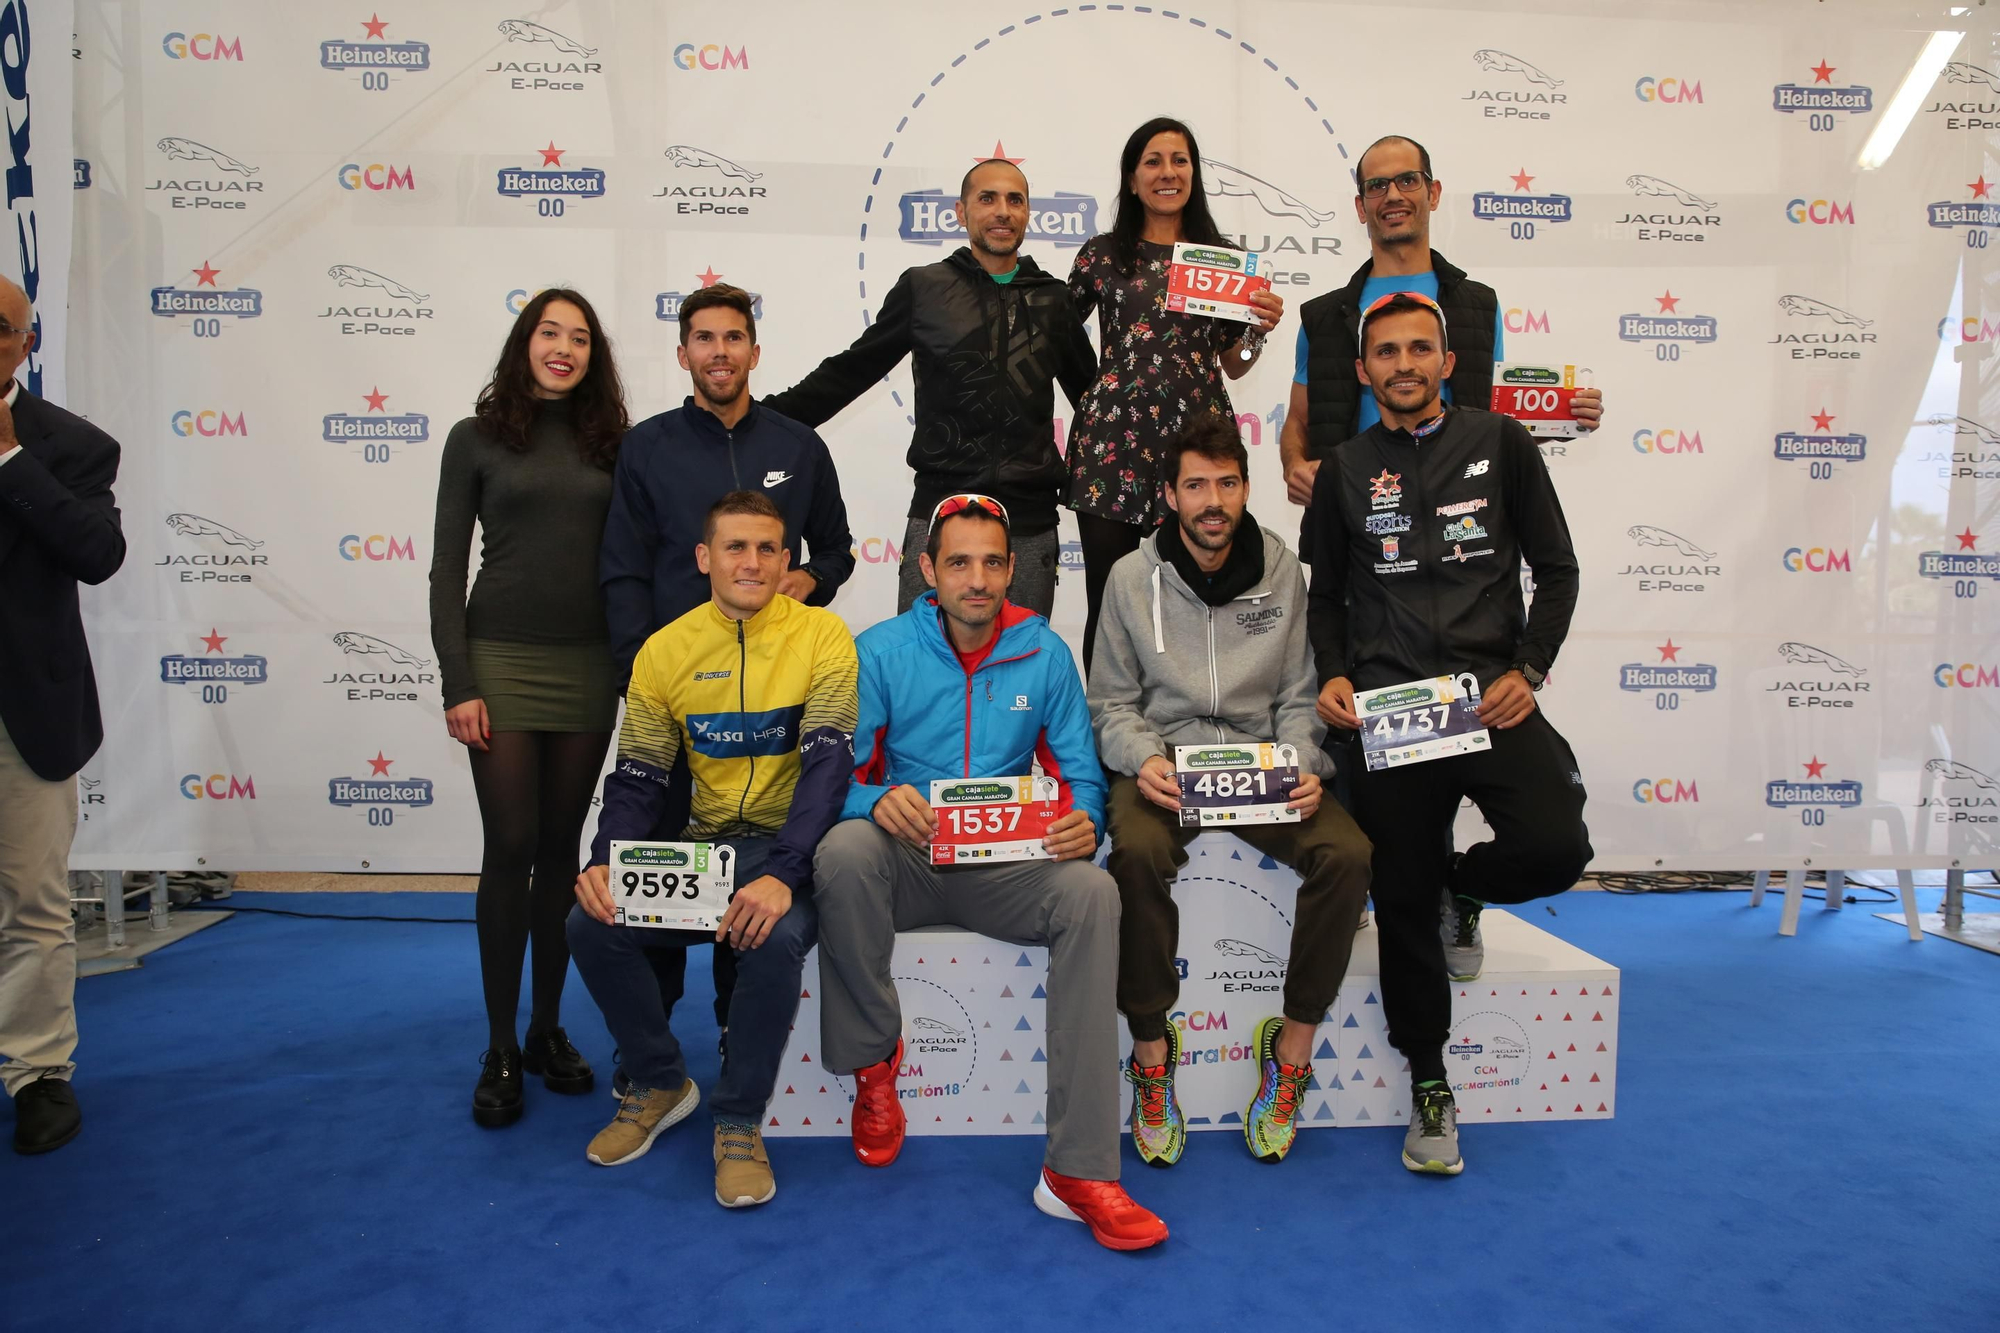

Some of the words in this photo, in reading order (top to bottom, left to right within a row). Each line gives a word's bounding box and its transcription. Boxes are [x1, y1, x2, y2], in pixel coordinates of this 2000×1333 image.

[162, 32, 244, 62] GCM
[326, 46, 424, 66] Heineken
[673, 43, 749, 71] GCM
[486, 61, 602, 75] JAGUAR
[511, 78, 584, 91] E-Pace
[1635, 76, 1703, 104] GCM
[1461, 90, 1567, 104] JAGUAR
[1779, 90, 1866, 108] Heineken
[1484, 107, 1550, 120] E-Pace
[1925, 102, 2000, 114] JAGU
[338, 164, 415, 191] GCM
[504, 174, 599, 192] Heineken
[145, 179, 264, 193] JAGUAR
[653, 186, 767, 198] JAGUAR
[172, 197, 247, 210] E-Pace
[677, 202, 749, 215] E-Pace
[1479, 197, 1567, 216] Heineken
[1786, 199, 1855, 225] GCM
[1934, 206, 2000, 222] Heinek
[1616, 214, 1721, 226] JAGUAR
[1639, 229, 1705, 242] E-Pace
[1202, 252, 1230, 260] cajasiete
[1248, 264, 1254, 272] 2
[1185, 268, 1246, 296] 1577
[157, 292, 256, 313] Heineken
[317, 307, 434, 320] JAGUAR
[1503, 308, 1550, 333] CM
[341, 323, 416, 336] E-Pace
[1625, 320, 1711, 337] Heineken
[1767, 333, 1877, 344] JAGUAR
[1791, 348, 1860, 360] E-Pace
[1567, 377, 1572, 386] 1
[1513, 389, 1558, 412] 100
[171, 410, 248, 437] GCM
[329, 419, 423, 438] Heineken
[1633, 429, 1704, 455] GCM
[1780, 439, 1861, 456] Heineken
[766, 471, 785, 480] NIKE
[1436, 498, 1488, 516] POWERGYM
[1366, 512, 1395, 521] european
[1365, 514, 1412, 534] sports
[1446, 522, 1463, 532] Club
[338, 534, 415, 562] GCM
[851, 537, 902, 563] CM
[154, 554, 269, 566] JAGUAR
[1783, 547, 1851, 574] GCM
[180, 571, 252, 583] E-Pace
[1618, 565, 1721, 577] JAGUAR
[1639, 580, 1705, 593] E-Pace
[1236, 606, 1283, 626] SALMING
[166, 660, 261, 679] Heineken
[1934, 663, 2000, 689] GCM
[323, 673, 435, 685] JAGUAR
[1626, 670, 1711, 687] Heineken
[1766, 681, 1870, 692] JAGUAR
[347, 689, 418, 701] E-Pace
[1387, 690, 1418, 700] cajasiete
[1788, 696, 1853, 709] E-Pace
[1373, 704, 1450, 738] 4737
[753, 727, 786, 742] HPS
[1209, 752, 1240, 760] cajasiete
[1264, 756, 1269, 765] 1
[179, 774, 256, 800] GCM
[334, 783, 427, 801] Heineken
[1194, 772, 1266, 798] 4821
[1633, 778, 1699, 804] GCM
[1022, 789, 1028, 800] 1
[1771, 786, 1856, 803] Heineken
[1913, 797, 1999, 808] JAGUA
[948, 806, 1022, 834] 1537
[698, 857, 706, 868] 3
[622, 872, 700, 899] 9593
[1224, 983, 1279, 992] E-Pace
[1169, 1011, 1228, 1031] GCM
[898, 1064, 923, 1077] CM
[1474, 1066, 1498, 1074] GCM
